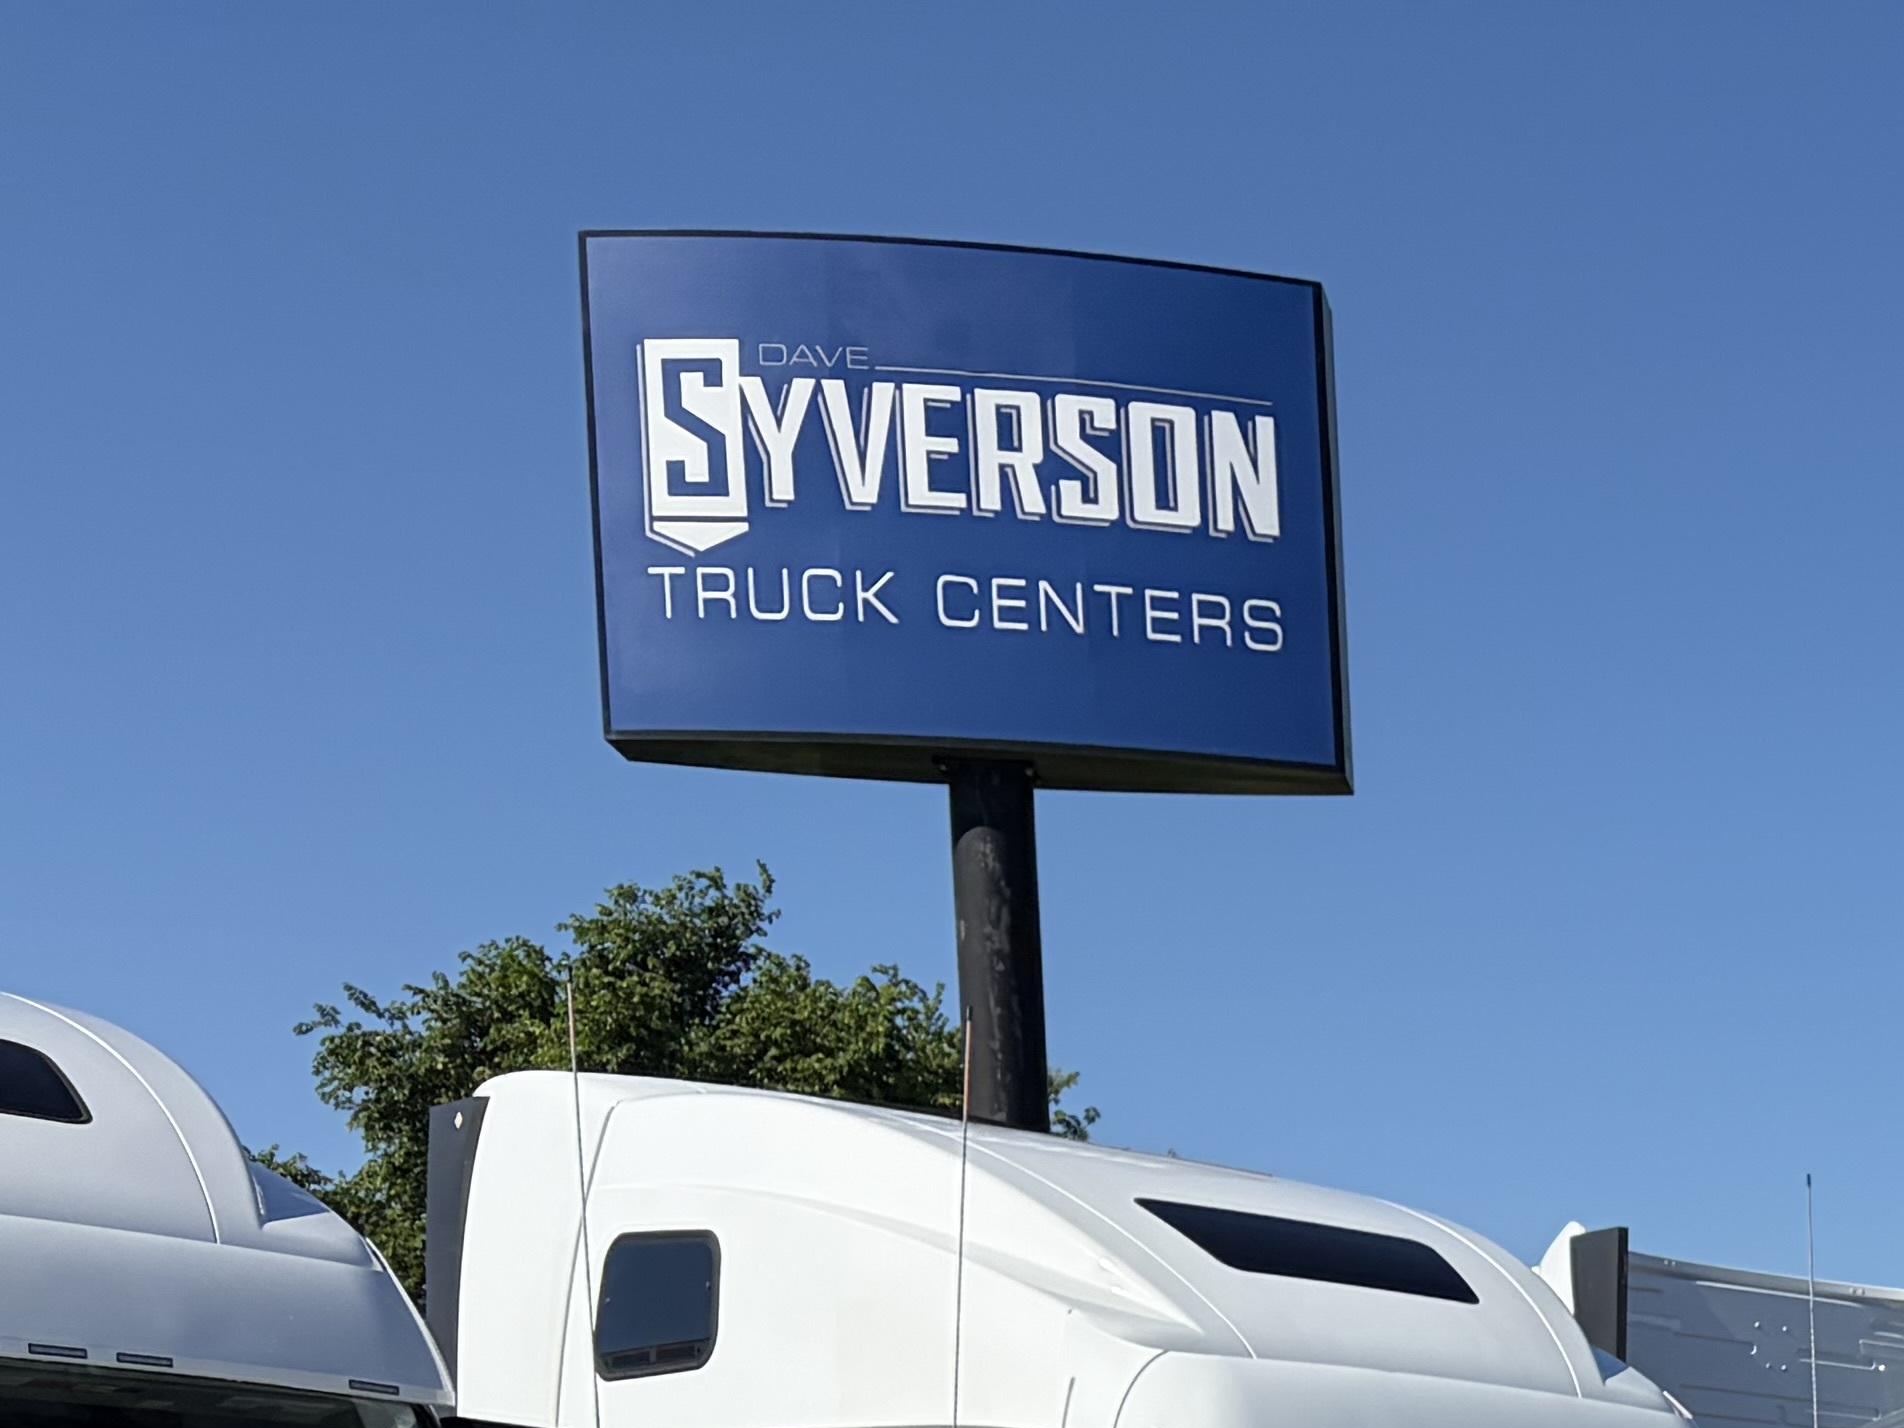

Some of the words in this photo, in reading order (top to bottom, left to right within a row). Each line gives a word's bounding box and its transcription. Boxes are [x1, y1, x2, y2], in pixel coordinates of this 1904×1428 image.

[758, 343, 870, 369] DAVE
[637, 338, 1283, 556] SYVERSON
[647, 564, 900, 626] TRUCK
[936, 574, 1285, 654] CENTERS
